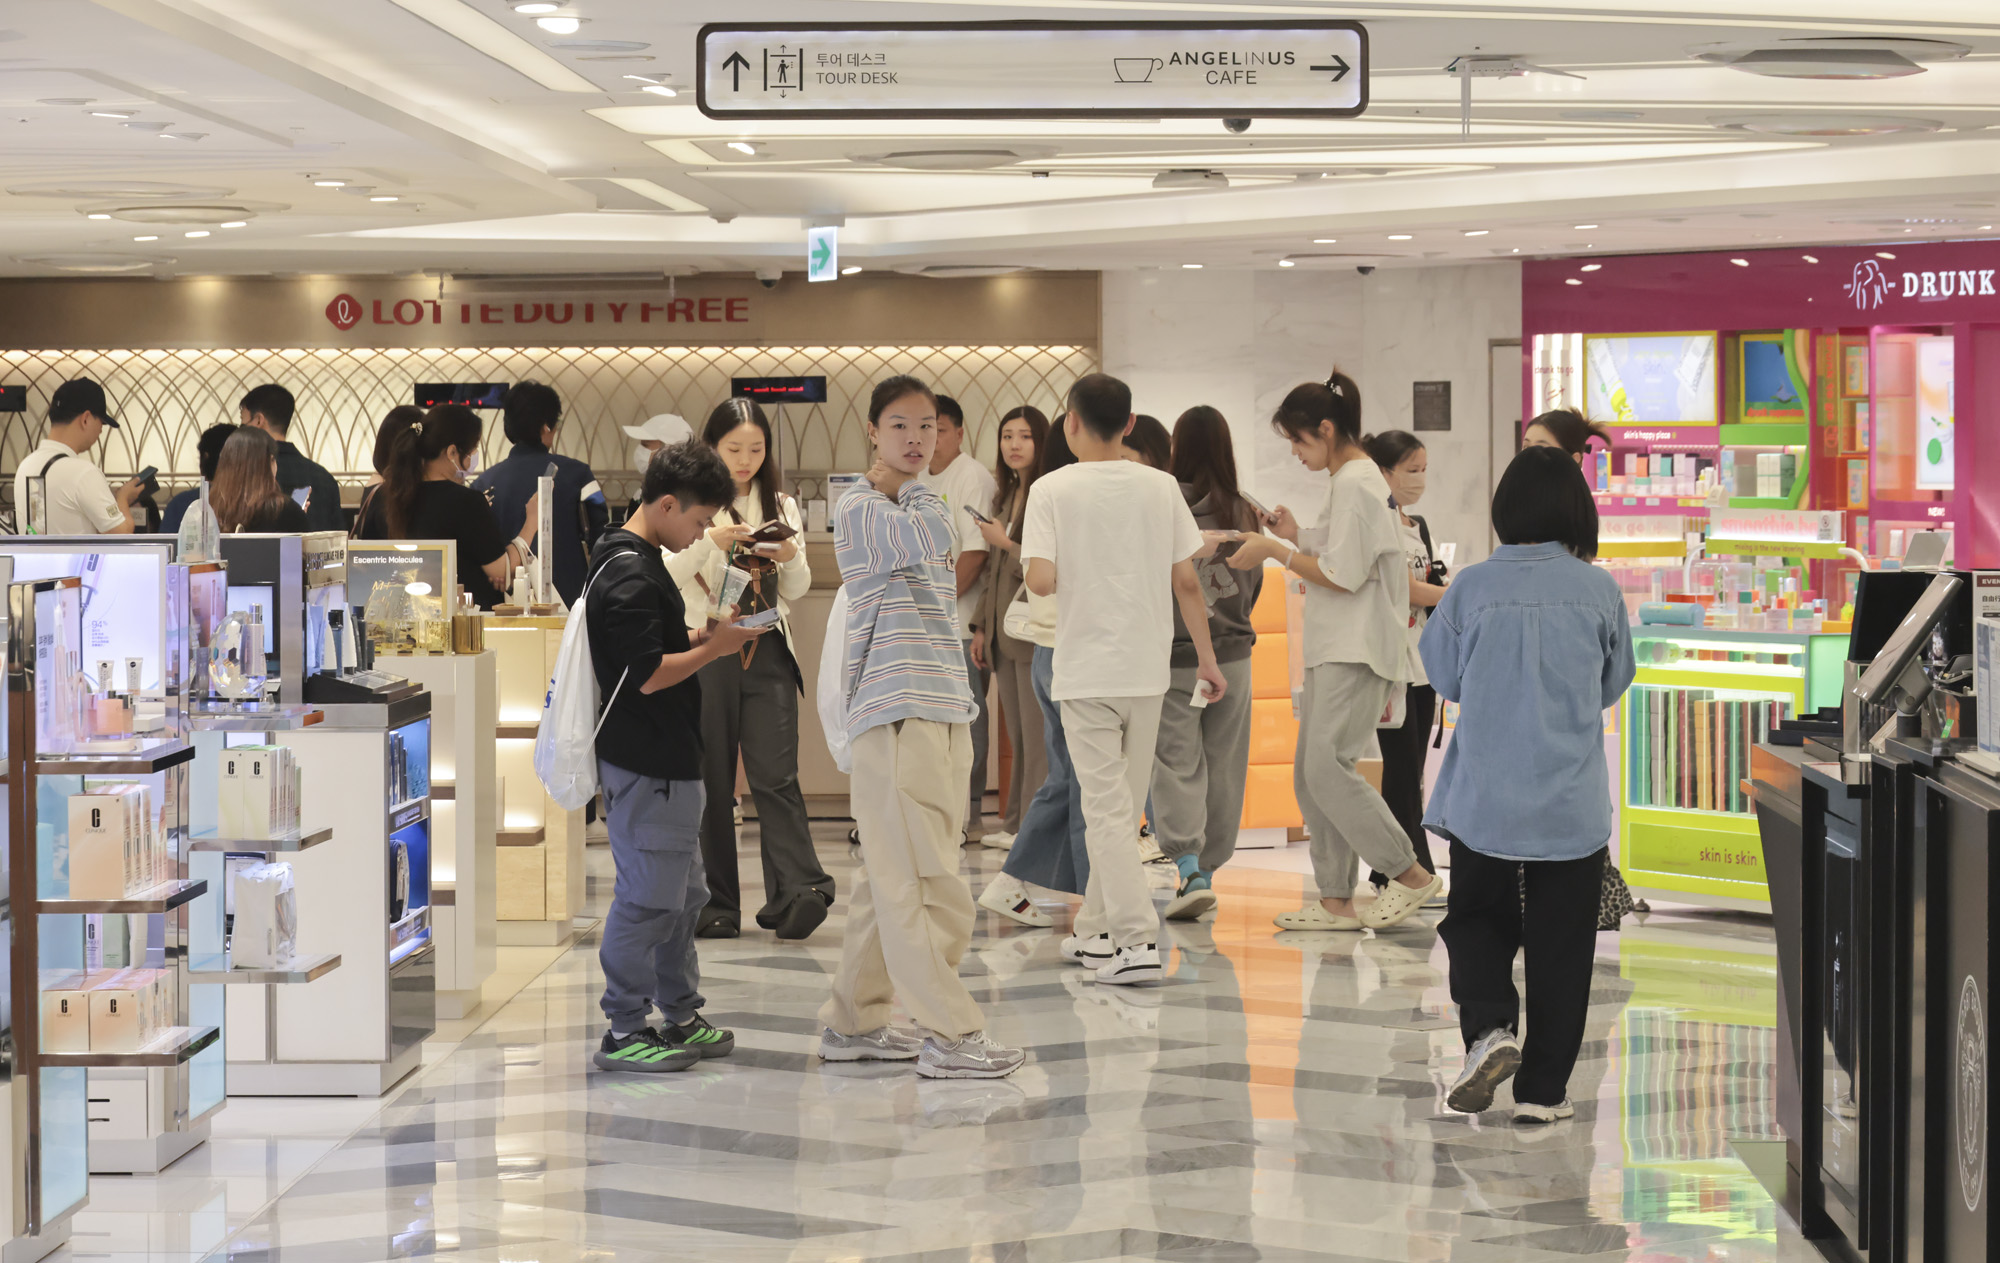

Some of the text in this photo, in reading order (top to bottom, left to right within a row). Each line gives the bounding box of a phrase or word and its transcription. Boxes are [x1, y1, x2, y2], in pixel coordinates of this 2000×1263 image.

[816, 53, 887, 67] 투어 데스크
[1169, 52, 1295, 65] ANGELINUS
[816, 72, 898, 84] TOUR DESK
[1206, 70, 1257, 85] CAFE
[1902, 269, 1996, 297] DRUNK
[1721, 513, 1795, 535] smoothie
[353, 556, 423, 564] Escentric Molecules
[1700, 847, 1757, 866] skin is skin
